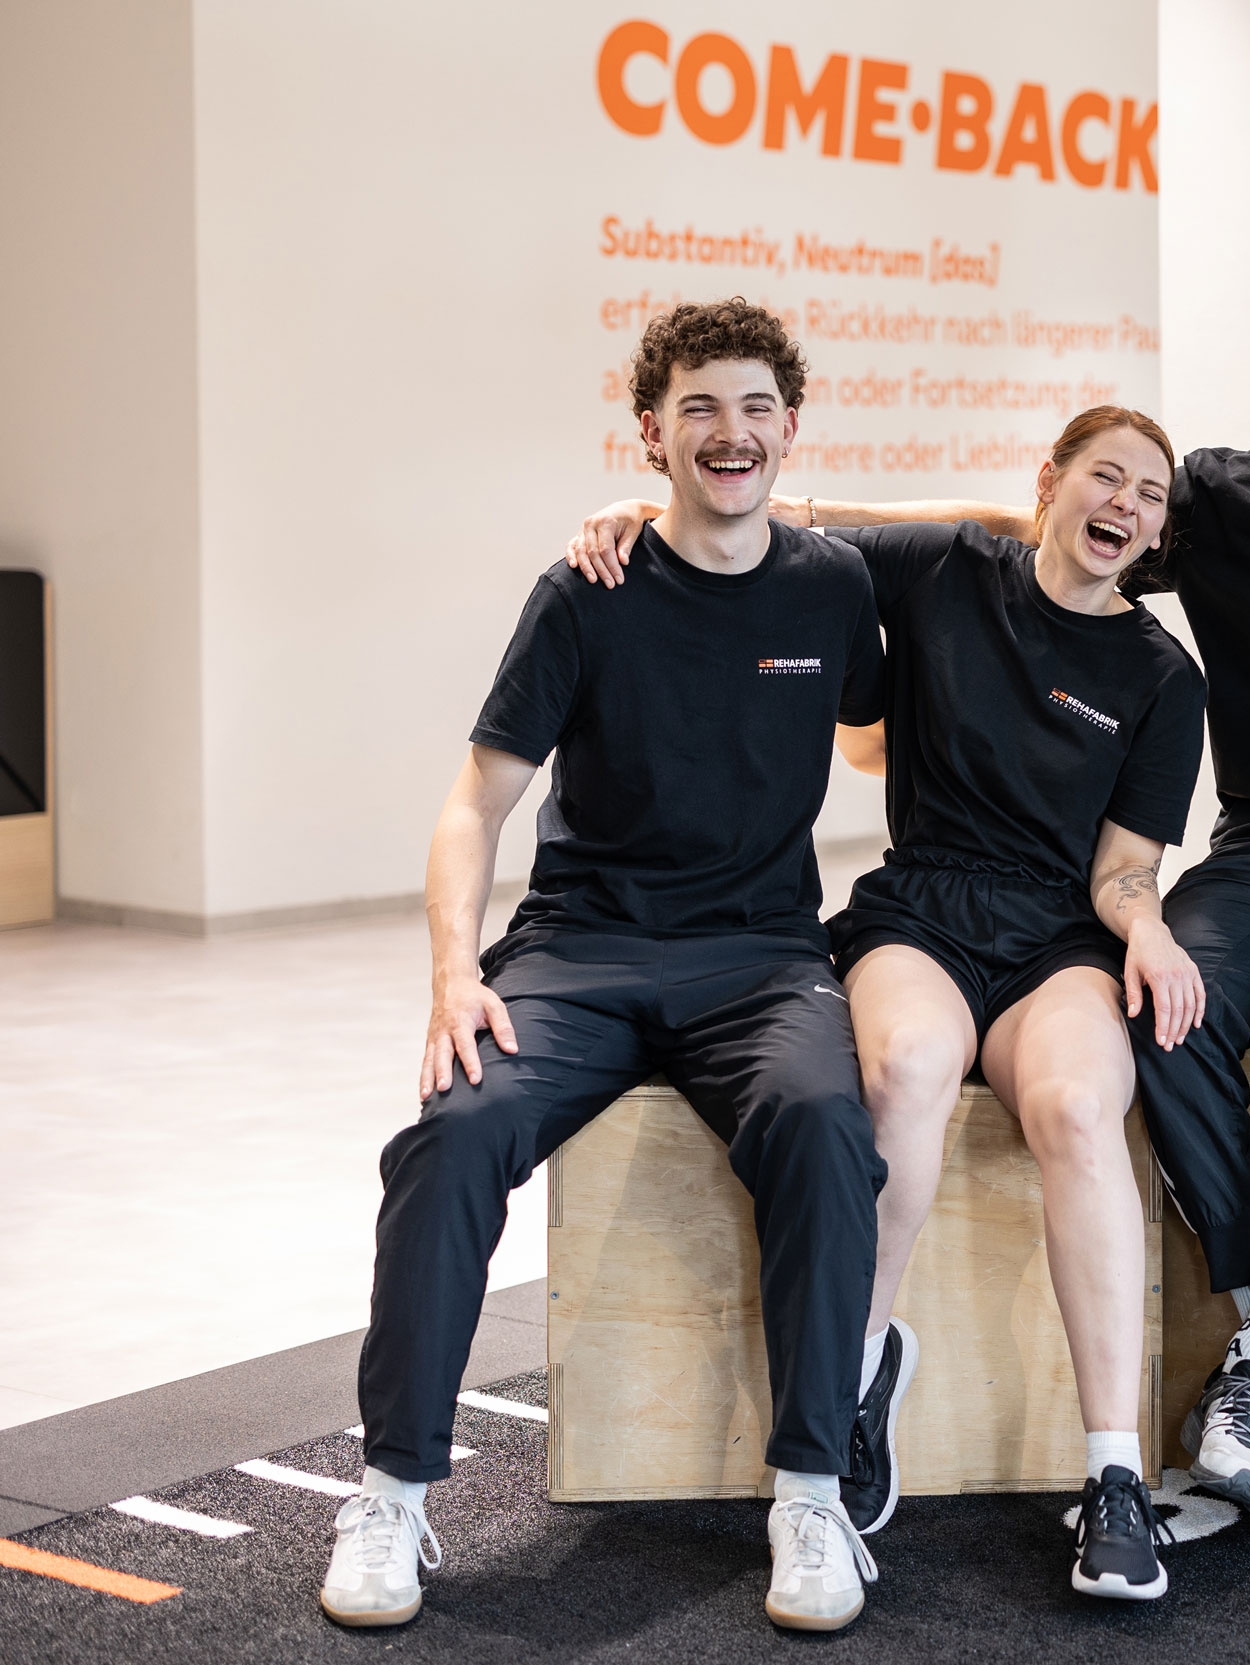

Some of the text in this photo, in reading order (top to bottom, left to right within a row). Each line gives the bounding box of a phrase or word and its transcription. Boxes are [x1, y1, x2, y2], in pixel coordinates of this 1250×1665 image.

[600, 216, 1001, 288] Substantiv, Neutrum [das]
[804, 298, 937, 345] Rückkehr
[942, 311, 1007, 349] nach
[1012, 312, 1113, 357] längerer
[838, 370, 904, 409] oder
[911, 368, 1065, 416] Fortsetzung
[882, 437, 945, 474] oder
[773, 658, 821, 668] REHAFABRIK
[1065, 695, 1120, 730] REHAFABRIK
